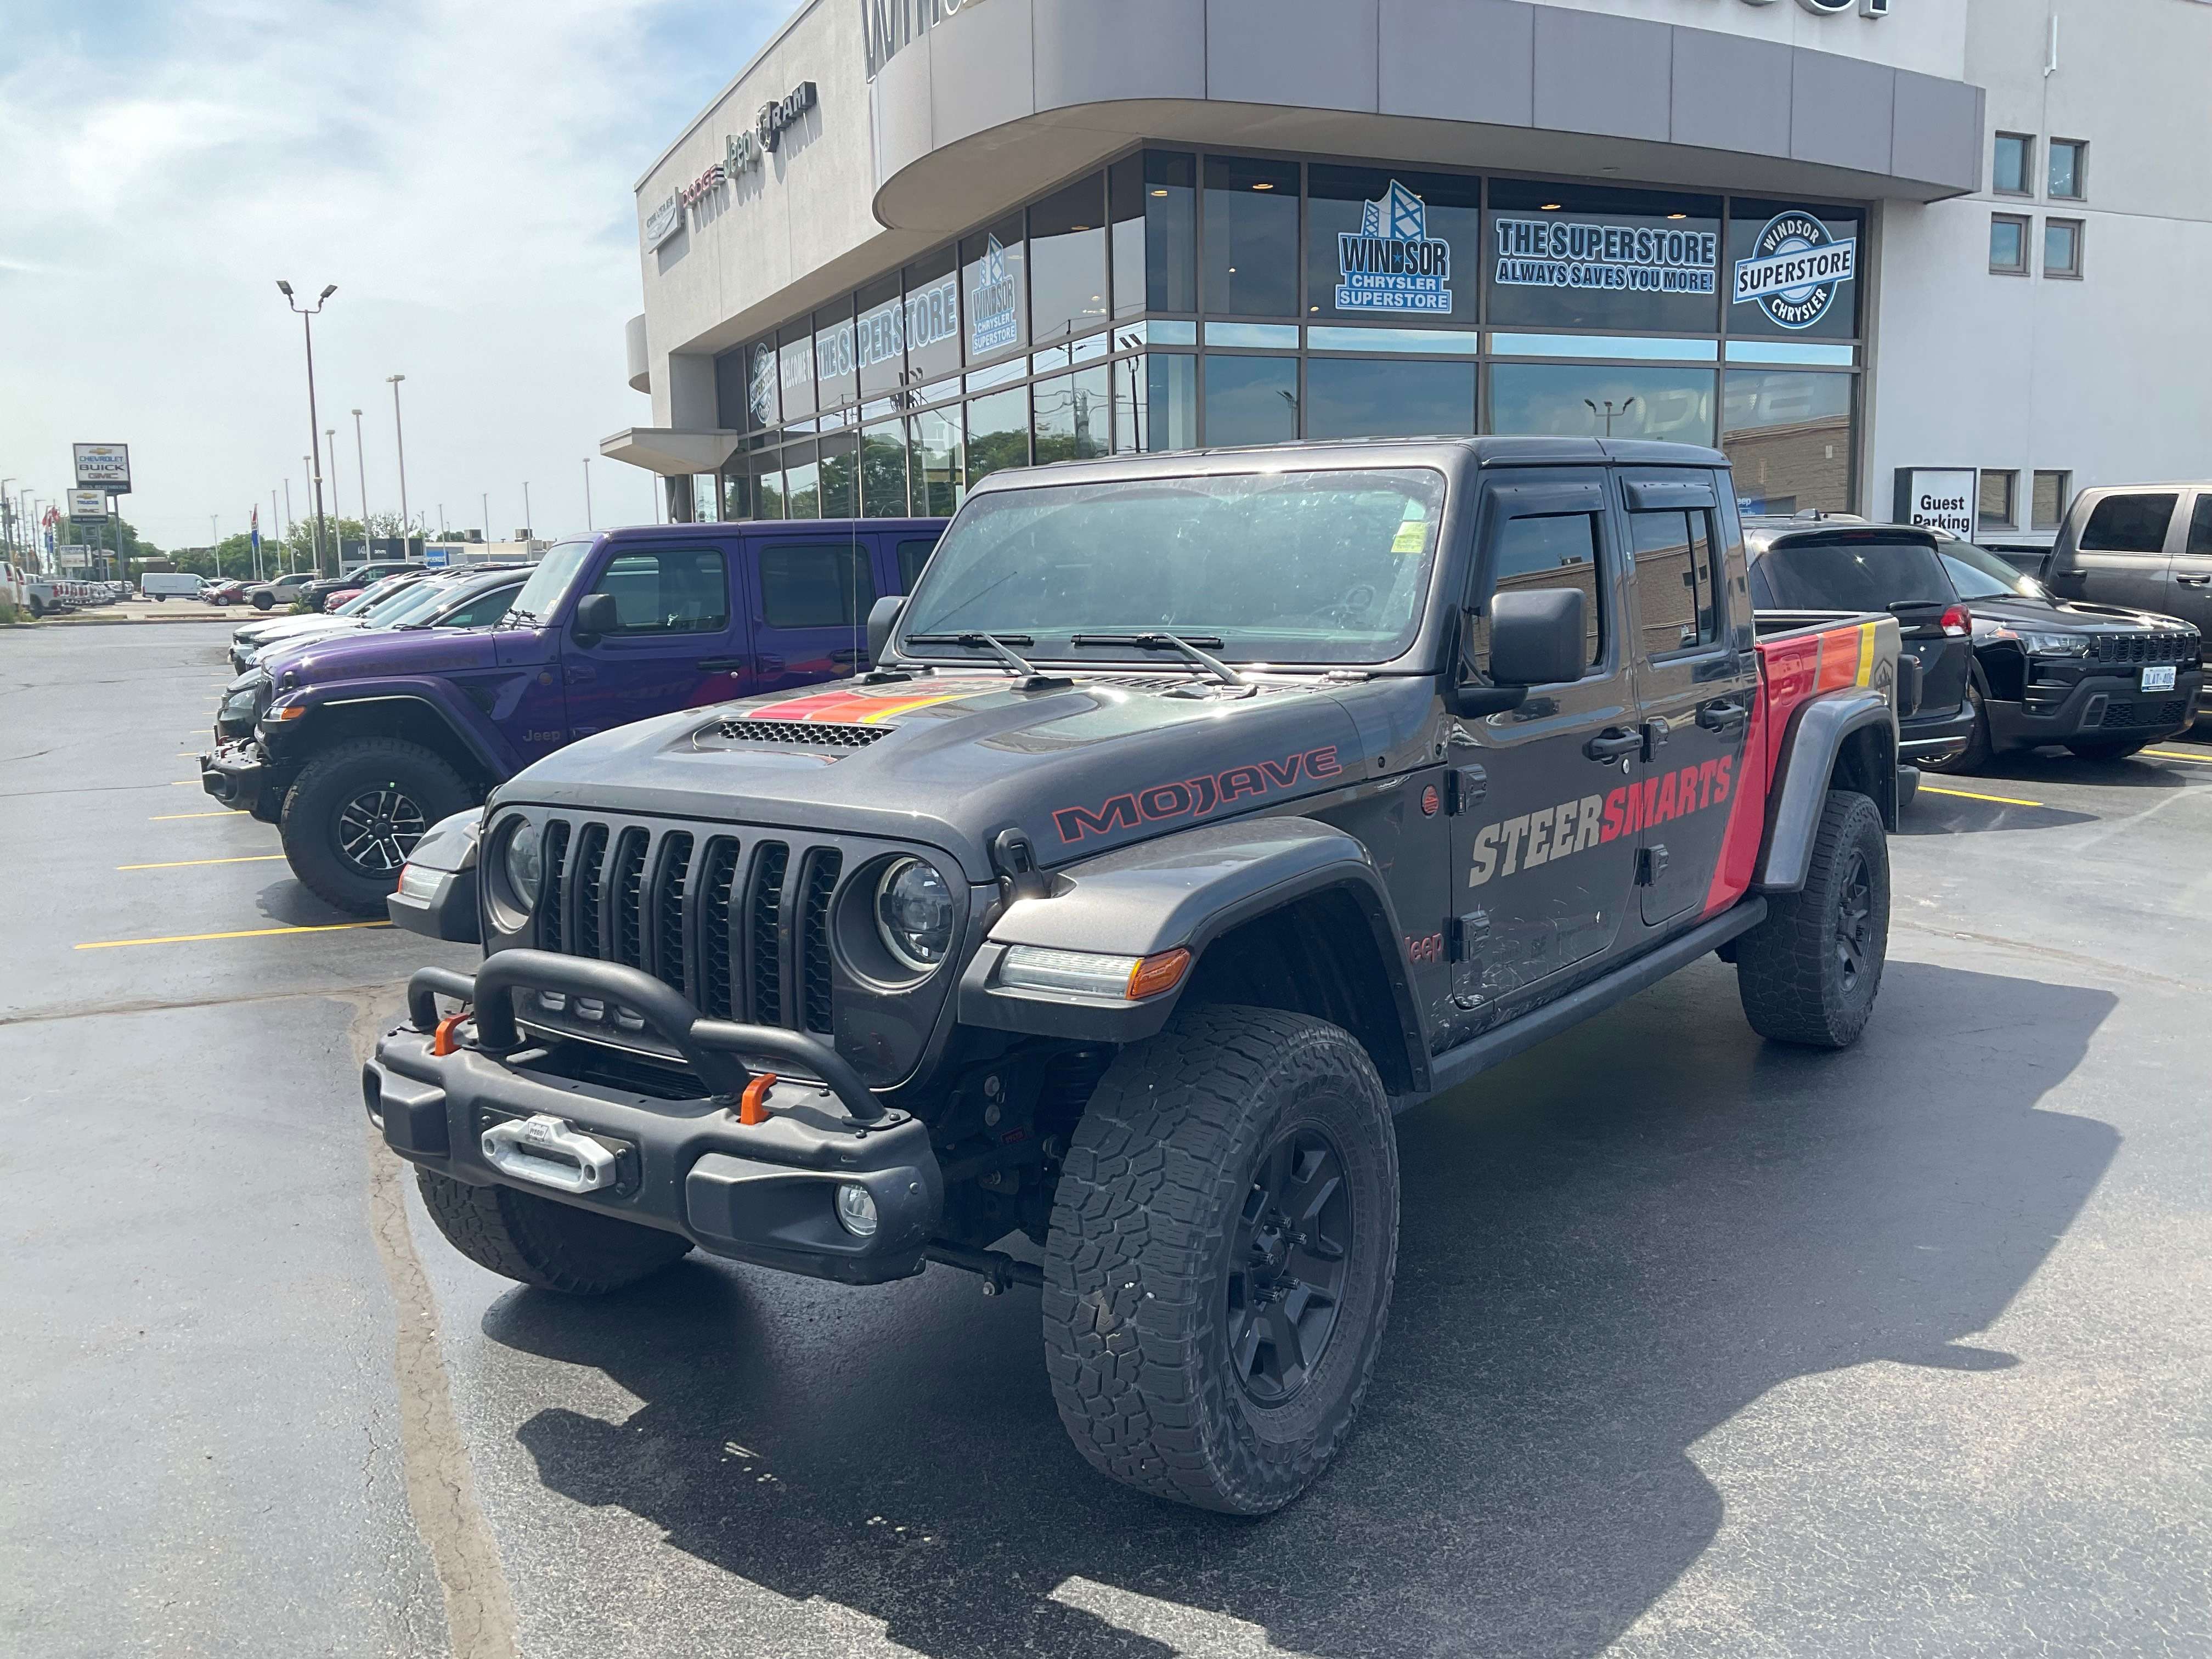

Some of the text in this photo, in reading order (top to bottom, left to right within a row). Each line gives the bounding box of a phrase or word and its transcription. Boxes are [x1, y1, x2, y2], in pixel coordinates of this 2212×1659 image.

[771, 81, 816, 131] RAM
[723, 130, 758, 179] Jeep
[682, 163, 724, 208] DODGE
[1498, 221, 1715, 266] THE SUPERSTORE
[1763, 220, 1819, 251] WINDSOR
[1342, 238, 1447, 276] WINDSOR
[1739, 250, 1850, 292] SUPERSTORE
[1352, 275, 1436, 290] CHRYSLER
[1498, 261, 1713, 292] ALWAYS SAVES YOU MORE!
[973, 279, 1014, 321] WINDSOR
[1340, 290, 1448, 308] SUPERSTORE
[1771, 288, 1827, 321] CHRYSLER
[817, 281, 957, 380] THE SUPERSTORE
[974, 325, 1015, 349] SUPERSTORE
[978, 313, 1010, 332] CHRYSLER
[1737, 498, 1751, 506] eep
[1920, 494, 1965, 510] Guest
[1914, 514, 1970, 533] Parking
[522, 730, 560, 742] Jeep
[1052, 746, 1342, 844] MOJAVE
